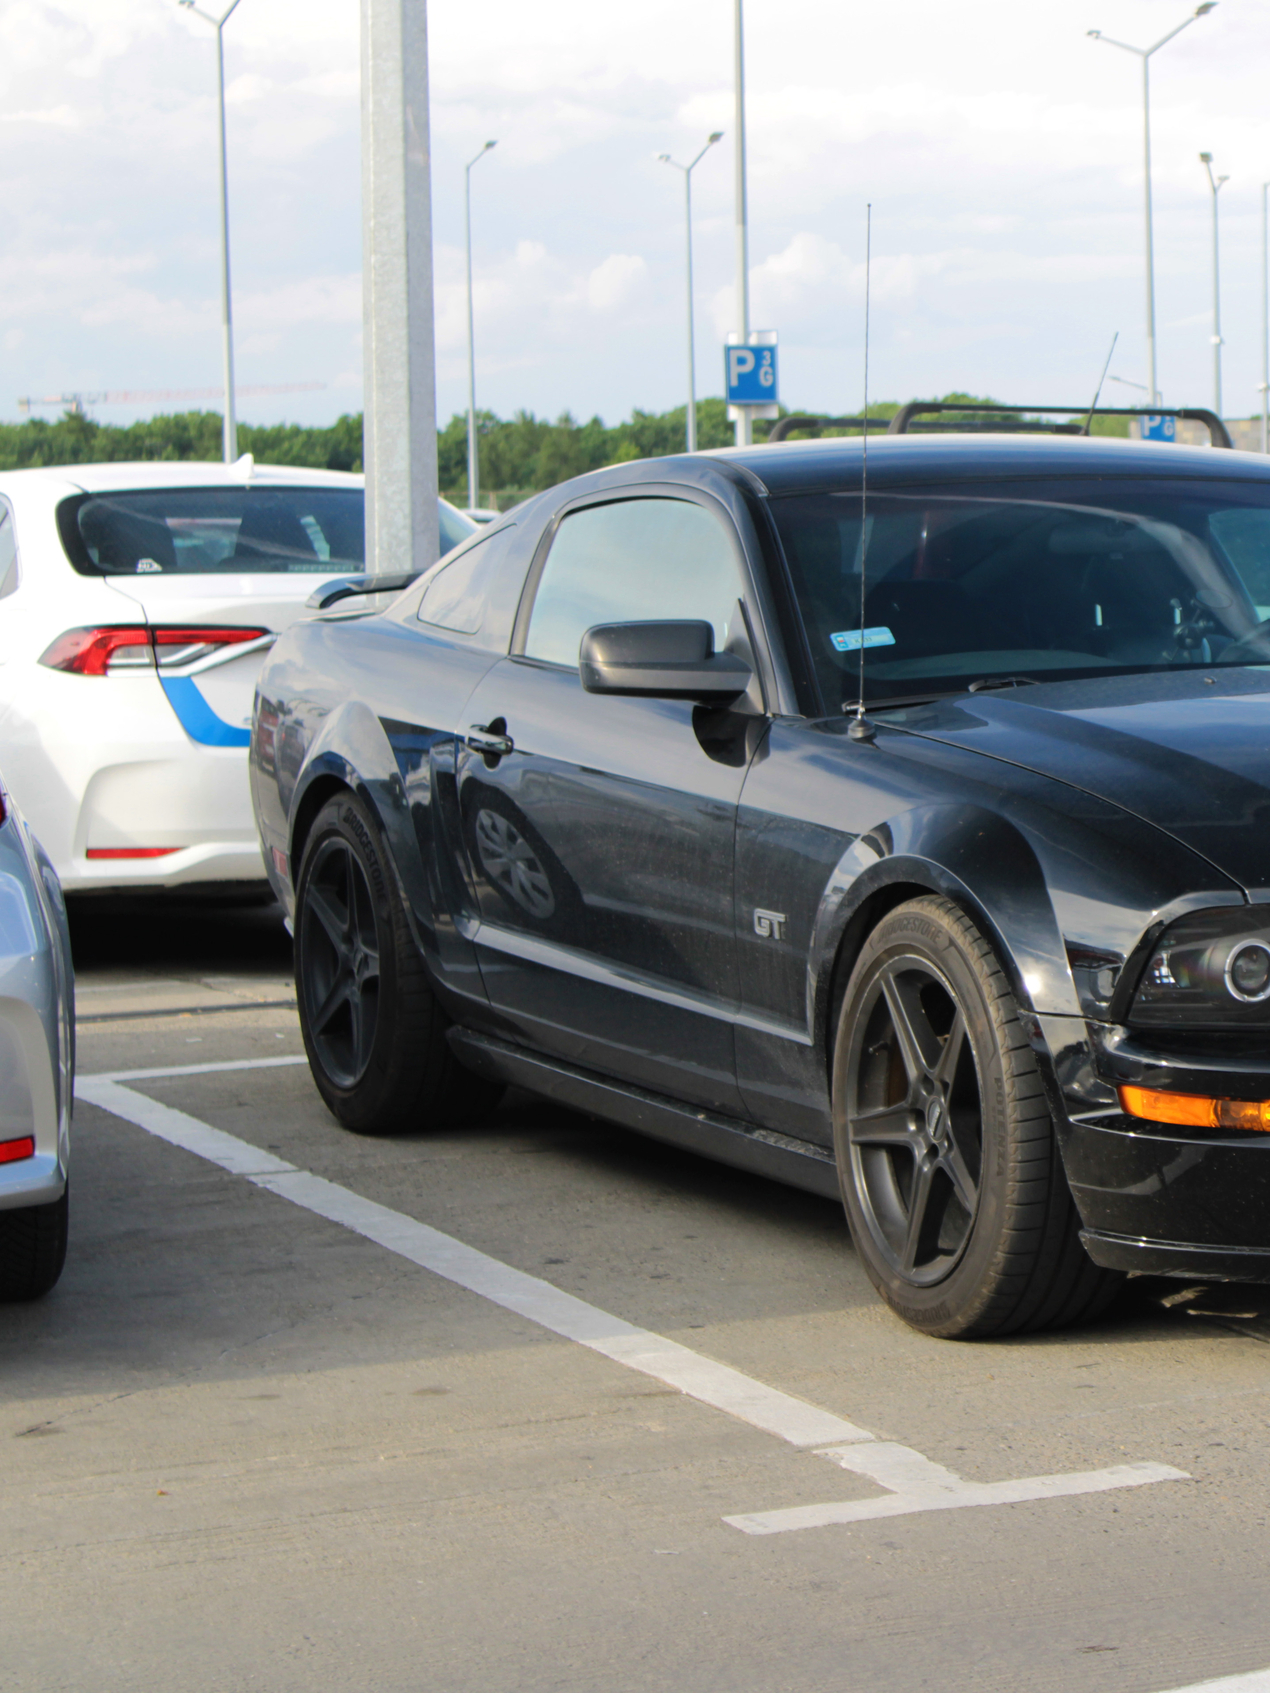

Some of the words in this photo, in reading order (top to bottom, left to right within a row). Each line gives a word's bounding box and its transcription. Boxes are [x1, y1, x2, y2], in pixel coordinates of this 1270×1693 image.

[729, 349, 755, 387] P
[763, 350, 771, 365] 3
[760, 366, 774, 387] G
[753, 908, 786, 940] GT
[994, 1077, 1006, 1177] POTENZA
